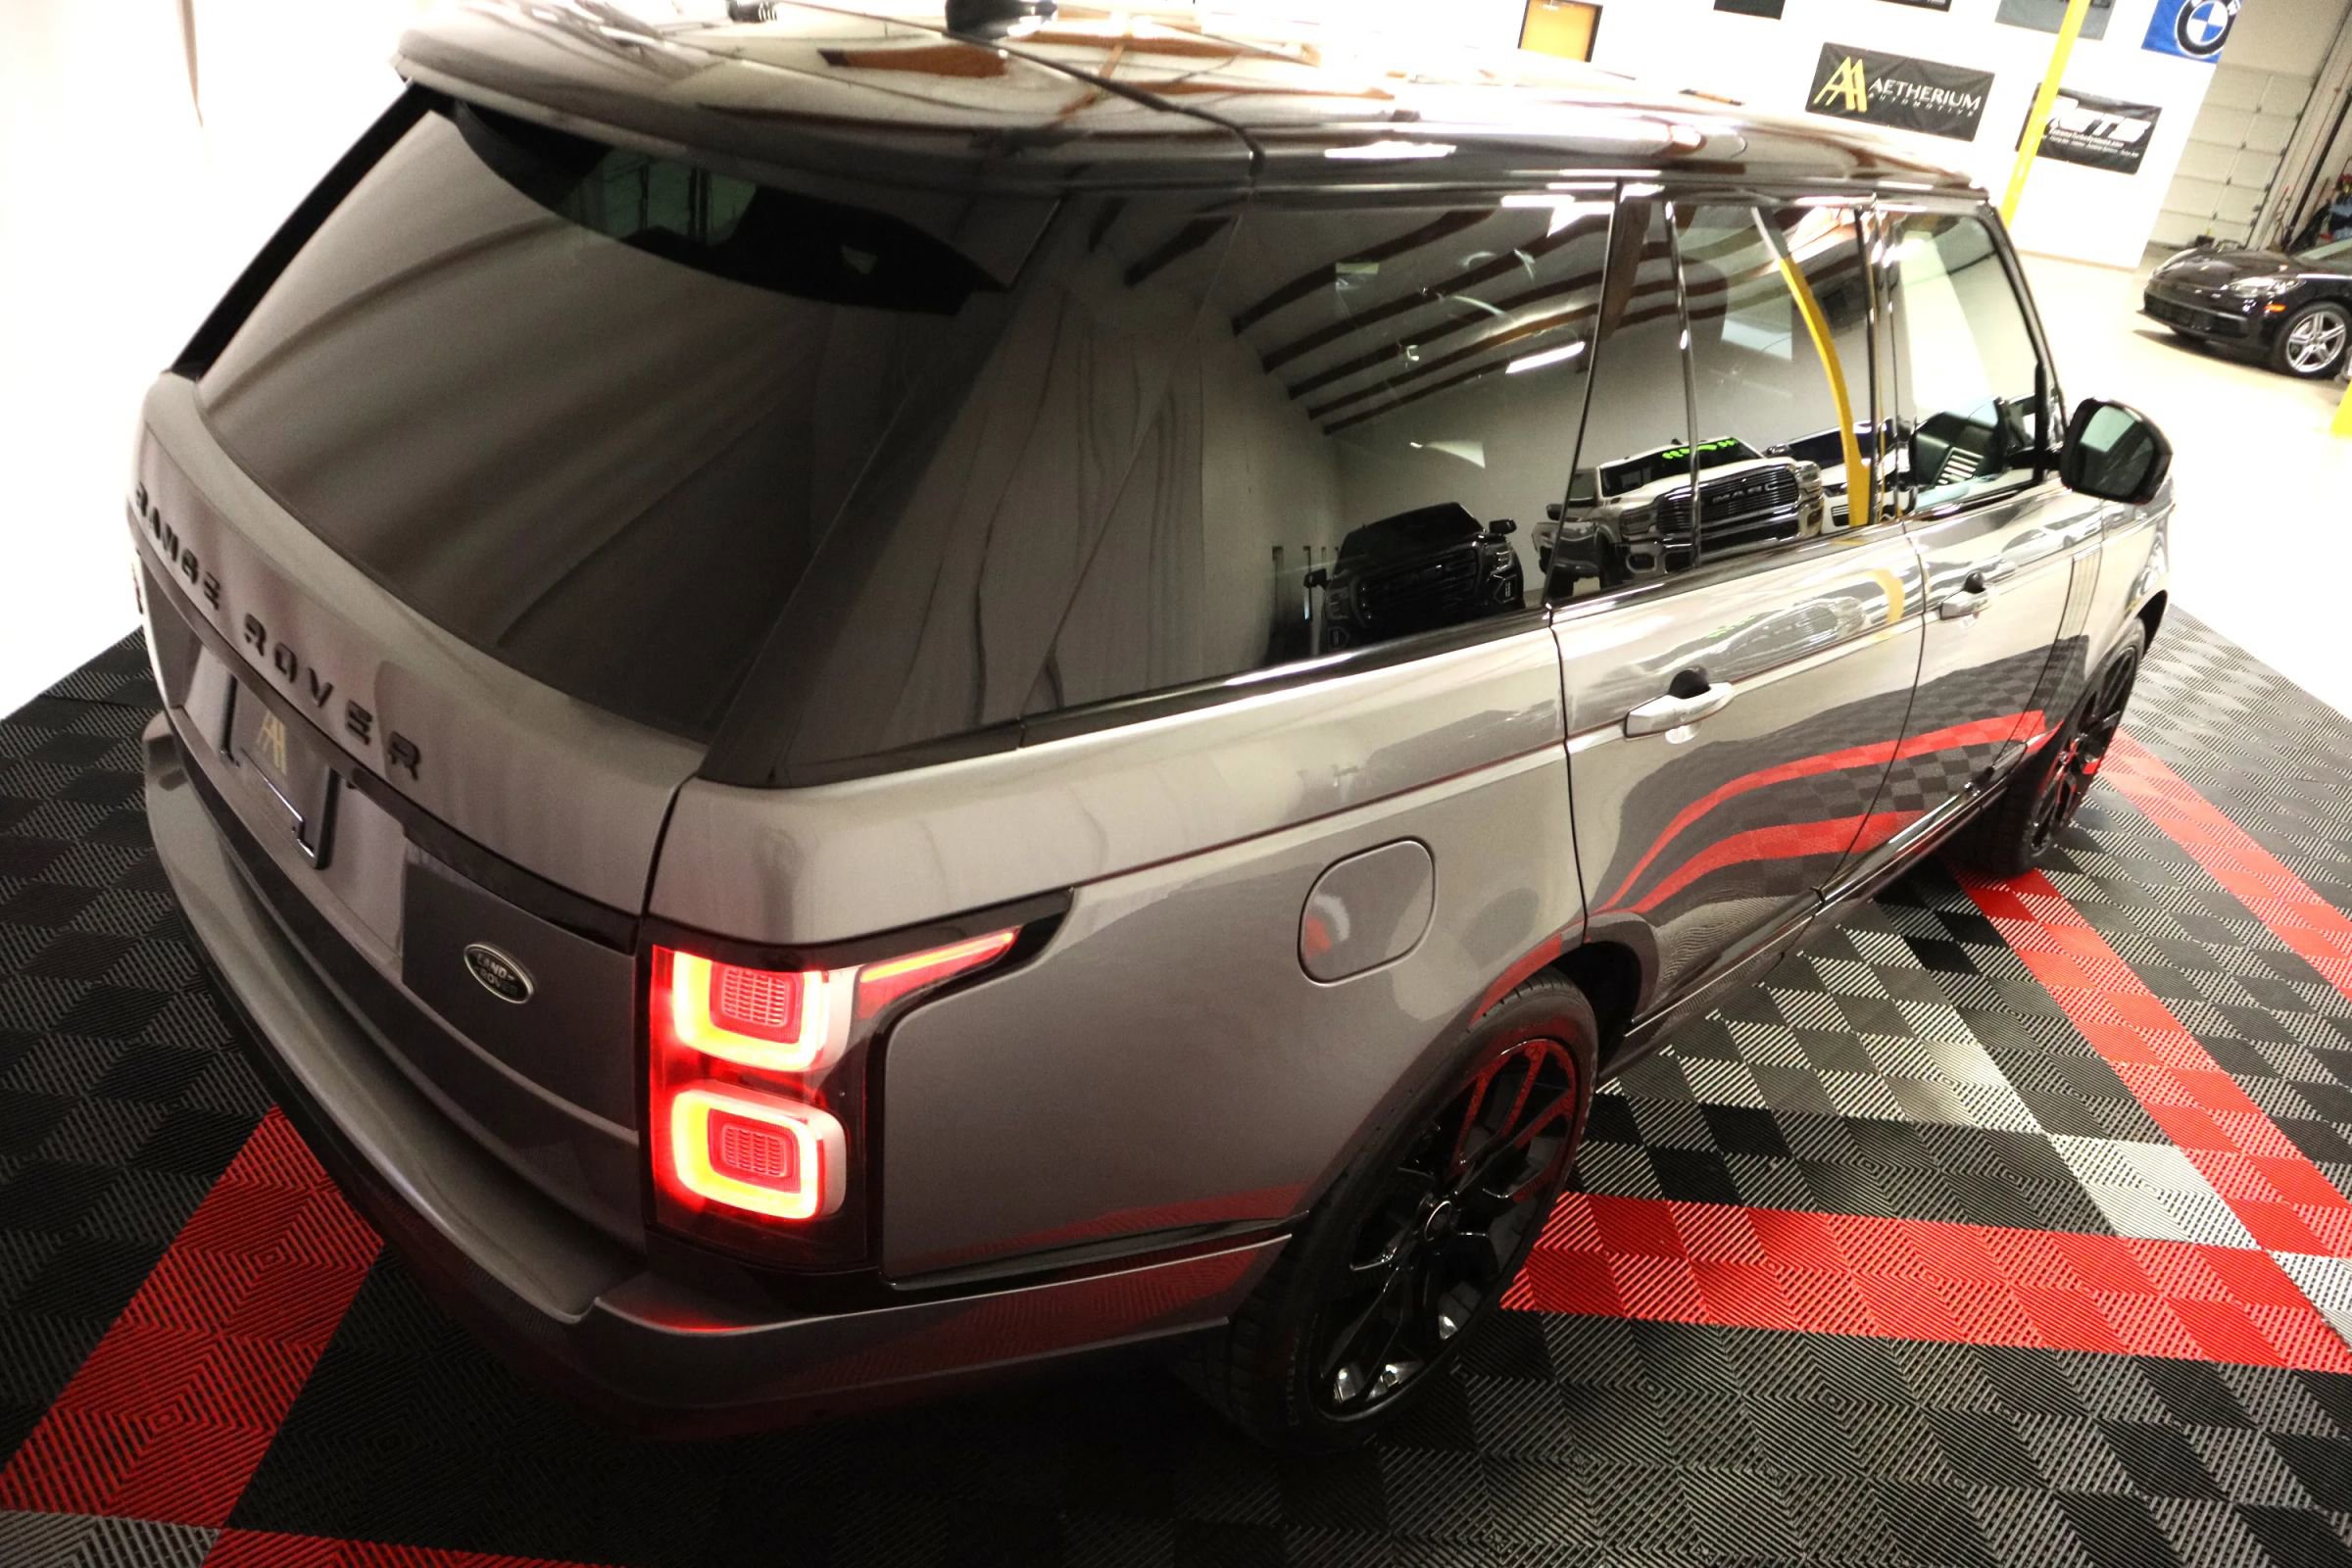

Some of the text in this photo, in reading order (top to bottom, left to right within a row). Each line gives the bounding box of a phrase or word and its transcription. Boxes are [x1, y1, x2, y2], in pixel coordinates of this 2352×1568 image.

[1868, 77, 1982, 111] AETHERIUM
[136, 480, 422, 782] RANGE ROVER
[477, 953, 508, 979] LAND
